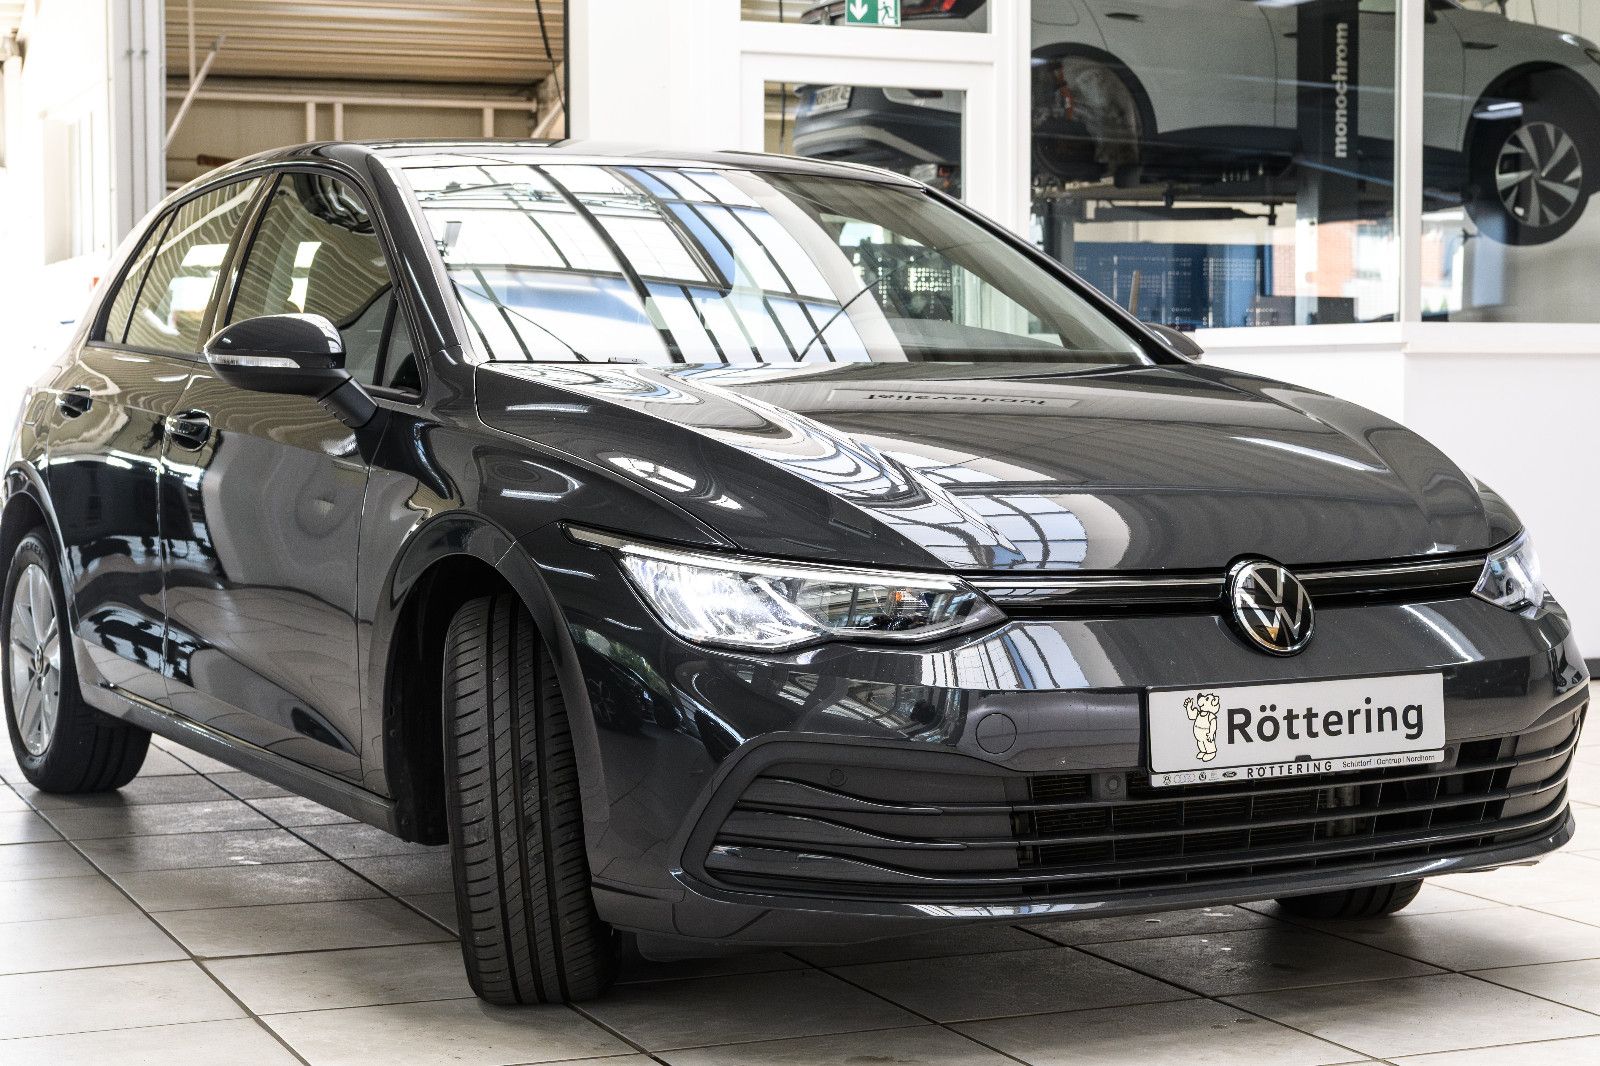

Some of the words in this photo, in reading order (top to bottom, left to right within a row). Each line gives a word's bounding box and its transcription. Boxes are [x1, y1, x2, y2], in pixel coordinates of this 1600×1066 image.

[1331, 22, 1348, 158] monochrom
[1227, 697, 1424, 745] Röttering
[1247, 761, 1332, 778] RÖTTERING
